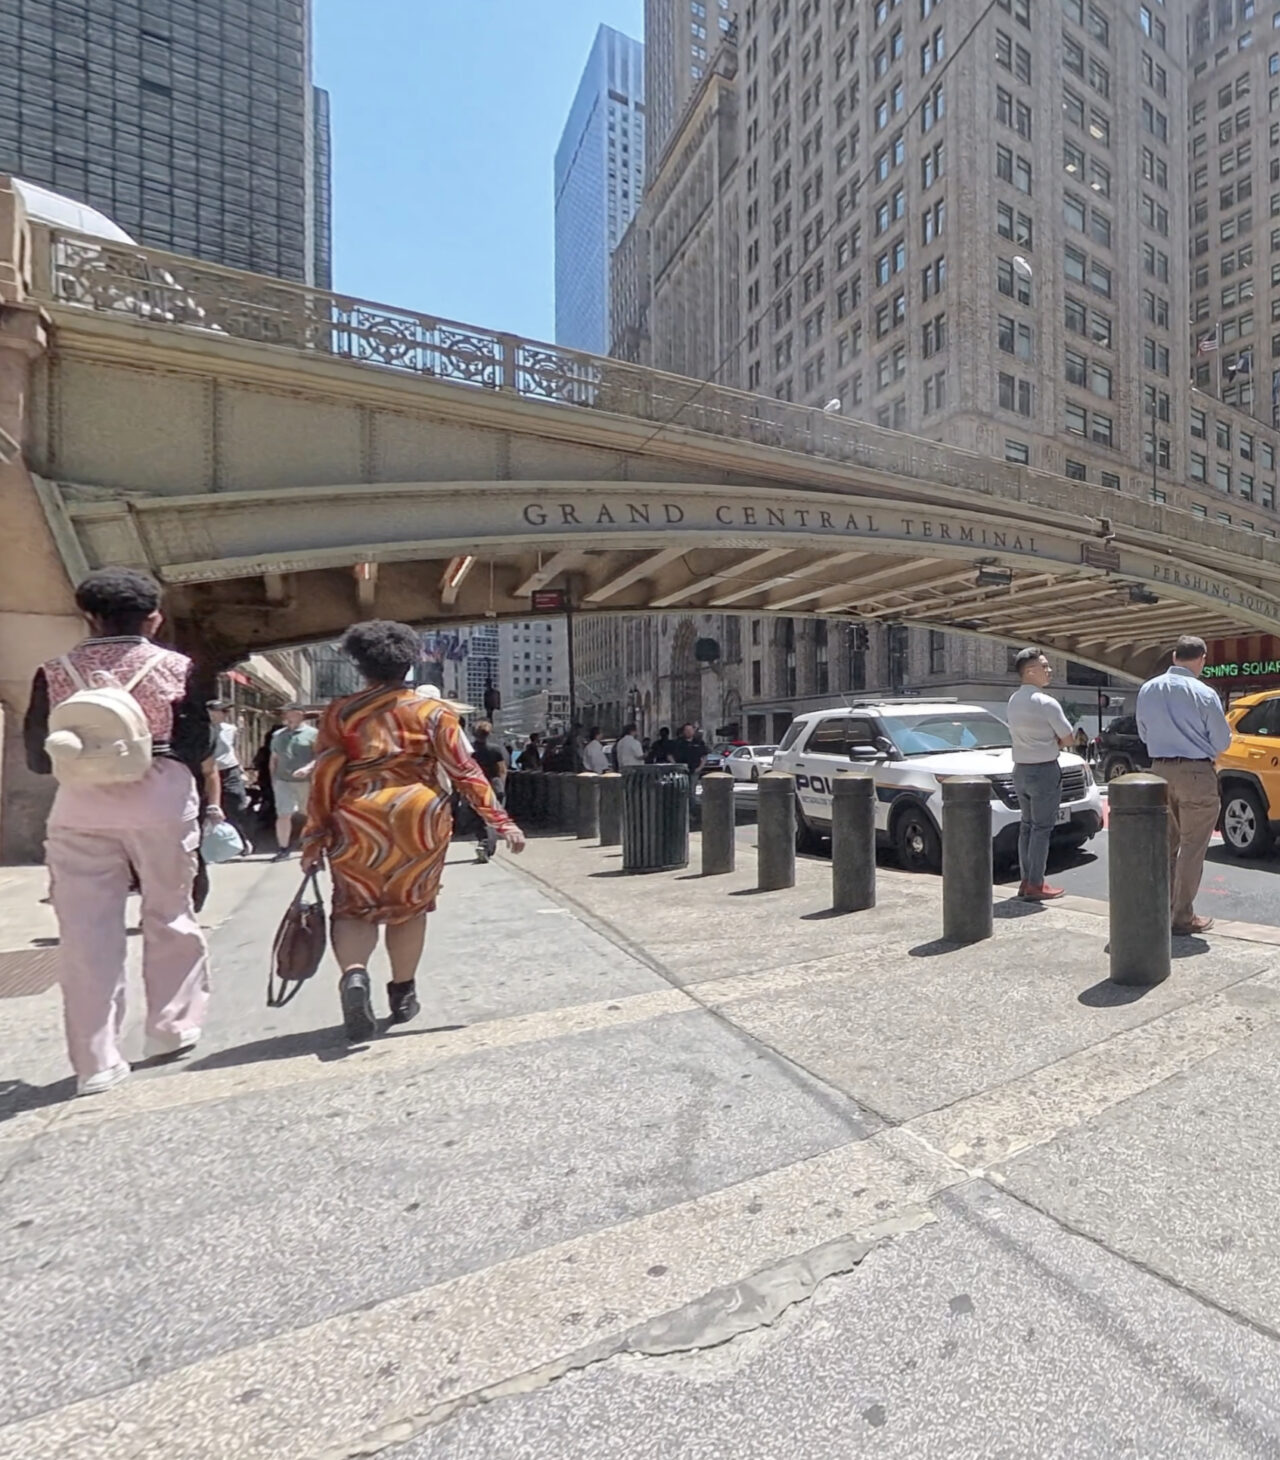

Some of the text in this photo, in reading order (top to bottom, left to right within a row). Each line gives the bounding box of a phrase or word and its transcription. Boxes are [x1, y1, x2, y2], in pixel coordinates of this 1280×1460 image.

[522, 503, 1039, 553] GRAND CENTRAL TERMINAL
[1152, 564, 1231, 599] PERSHING
[1203, 663, 1239, 678] SHING
[795, 774, 833, 795] POL
